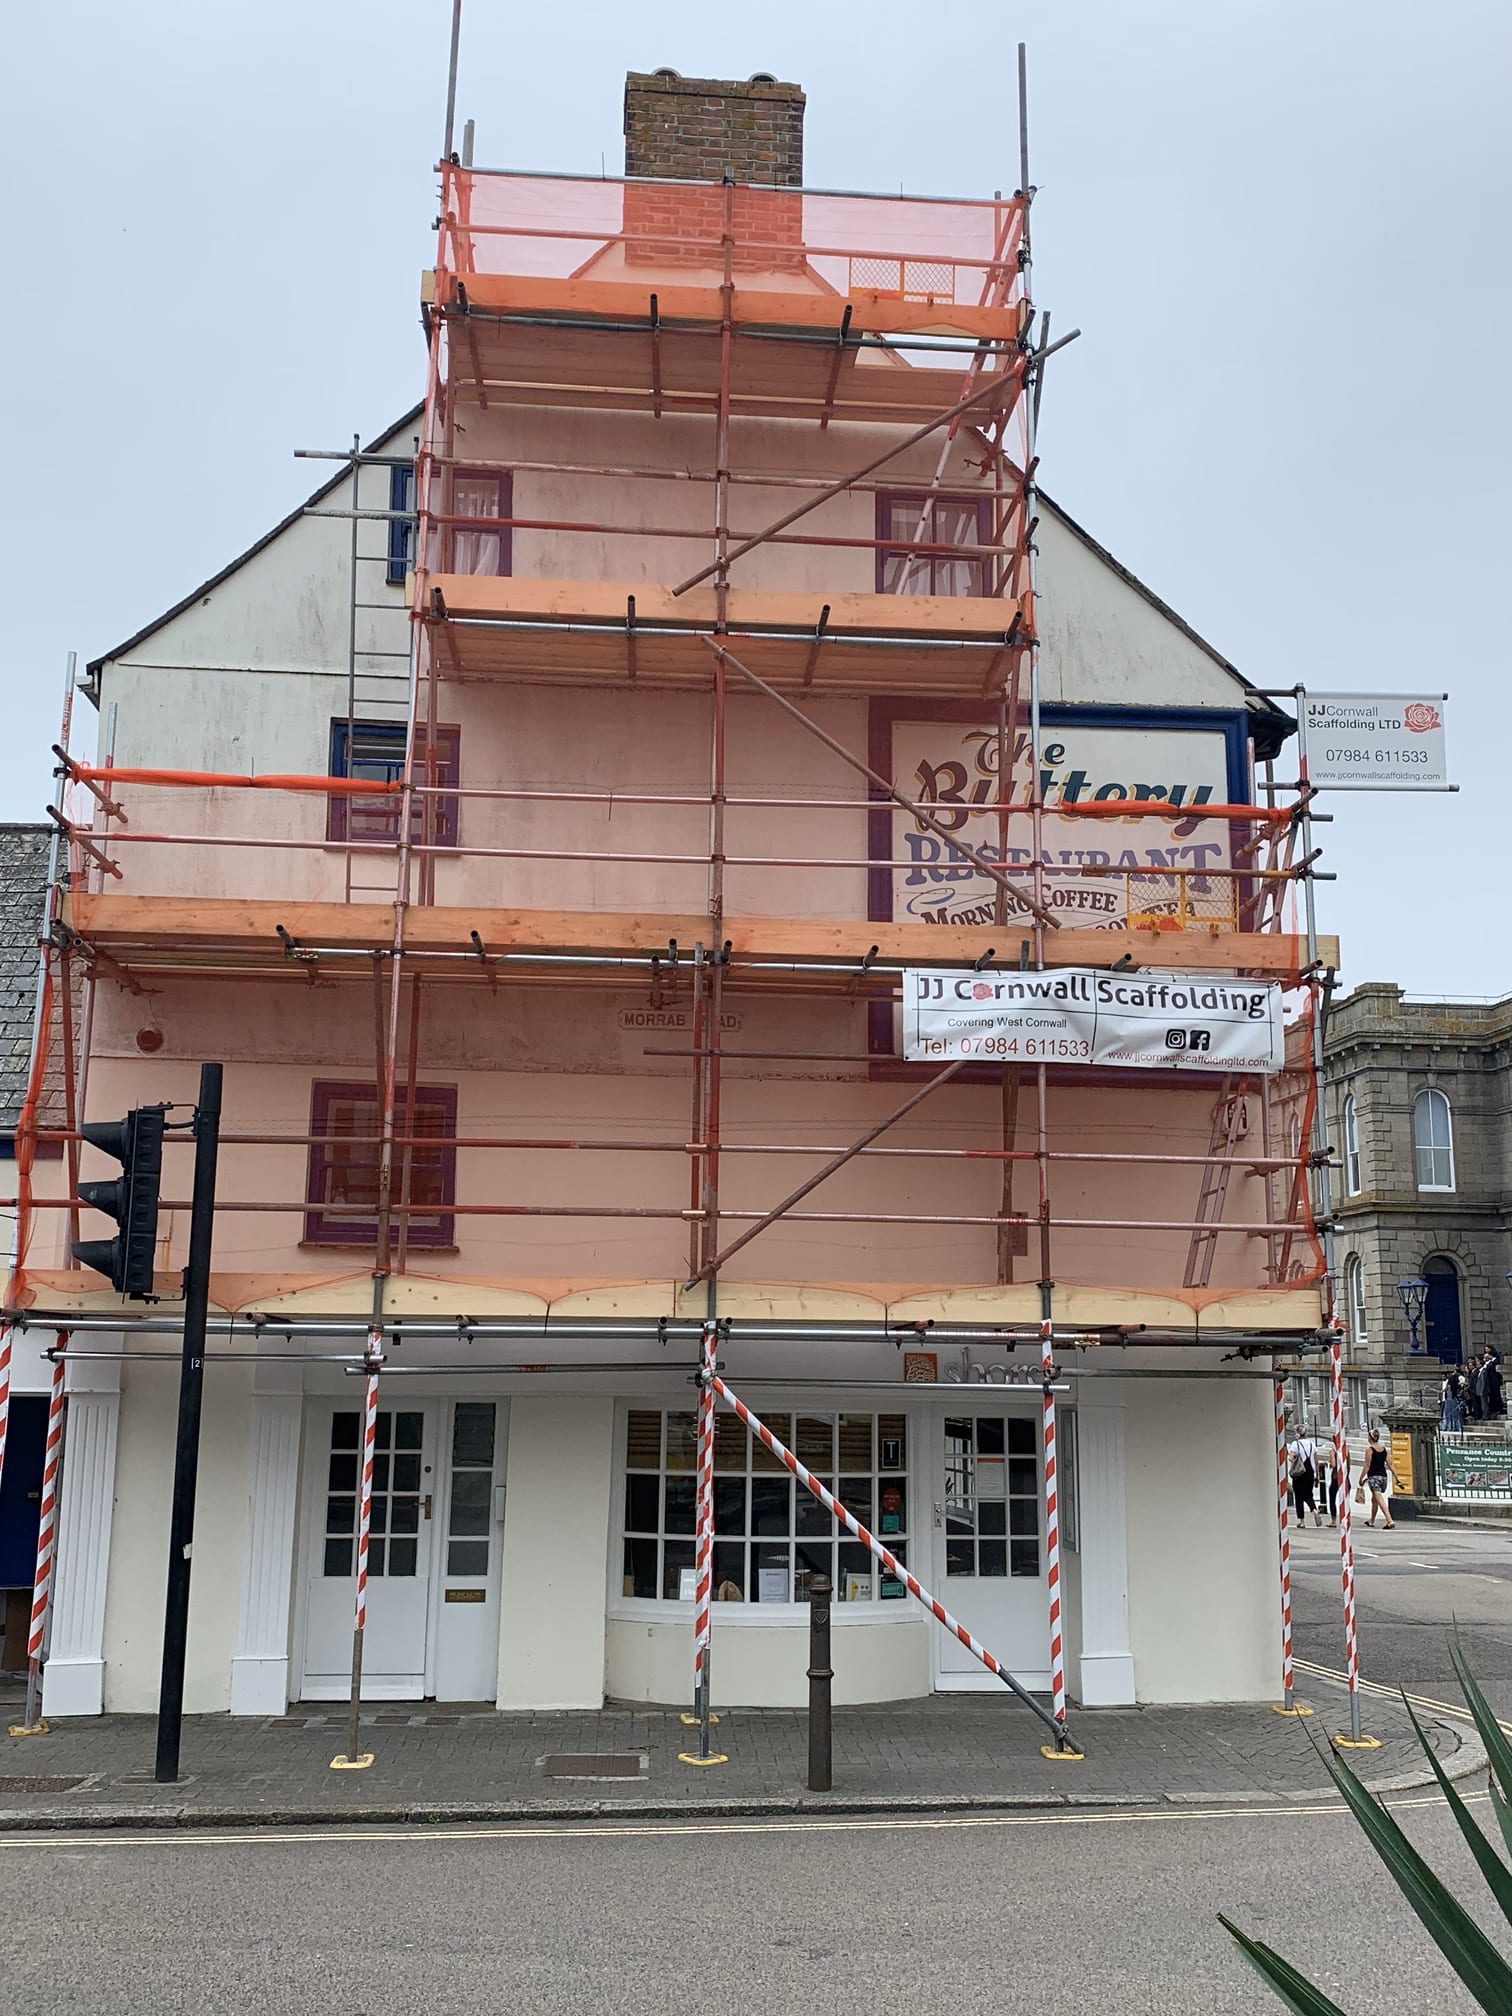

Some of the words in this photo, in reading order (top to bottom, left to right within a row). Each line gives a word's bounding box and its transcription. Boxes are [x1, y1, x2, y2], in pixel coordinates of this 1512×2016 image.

[1308, 718, 1375, 731] Scaffolding
[1378, 719, 1401, 730] LTD
[961, 730, 1066, 774] The
[1326, 749, 1370, 762] 07984
[1375, 750, 1428, 763] 611533
[1315, 771, 1440, 781] www.jjcornwallscaffolding.com
[914, 758, 1214, 838] Buttery
[920, 896, 1034, 926] MORNNG
[1041, 882, 1119, 913] COFFEE
[918, 977, 943, 1000] JJ
[954, 976, 1091, 1001] Crnwall
[1097, 979, 1266, 1019] Scaffolding
[624, 1013, 686, 1026] MORRAB
[947, 1018, 994, 1029] Covering
[996, 1016, 1023, 1028] West
[1025, 1017, 1067, 1029] Cornwall
[920, 1037, 953, 1055] Tel:
[960, 1037, 1019, 1055] 07984
[1025, 1038, 1090, 1056] 611533
[194, 1359, 201, 1368] 2
[943, 1346, 1044, 1384] shore
